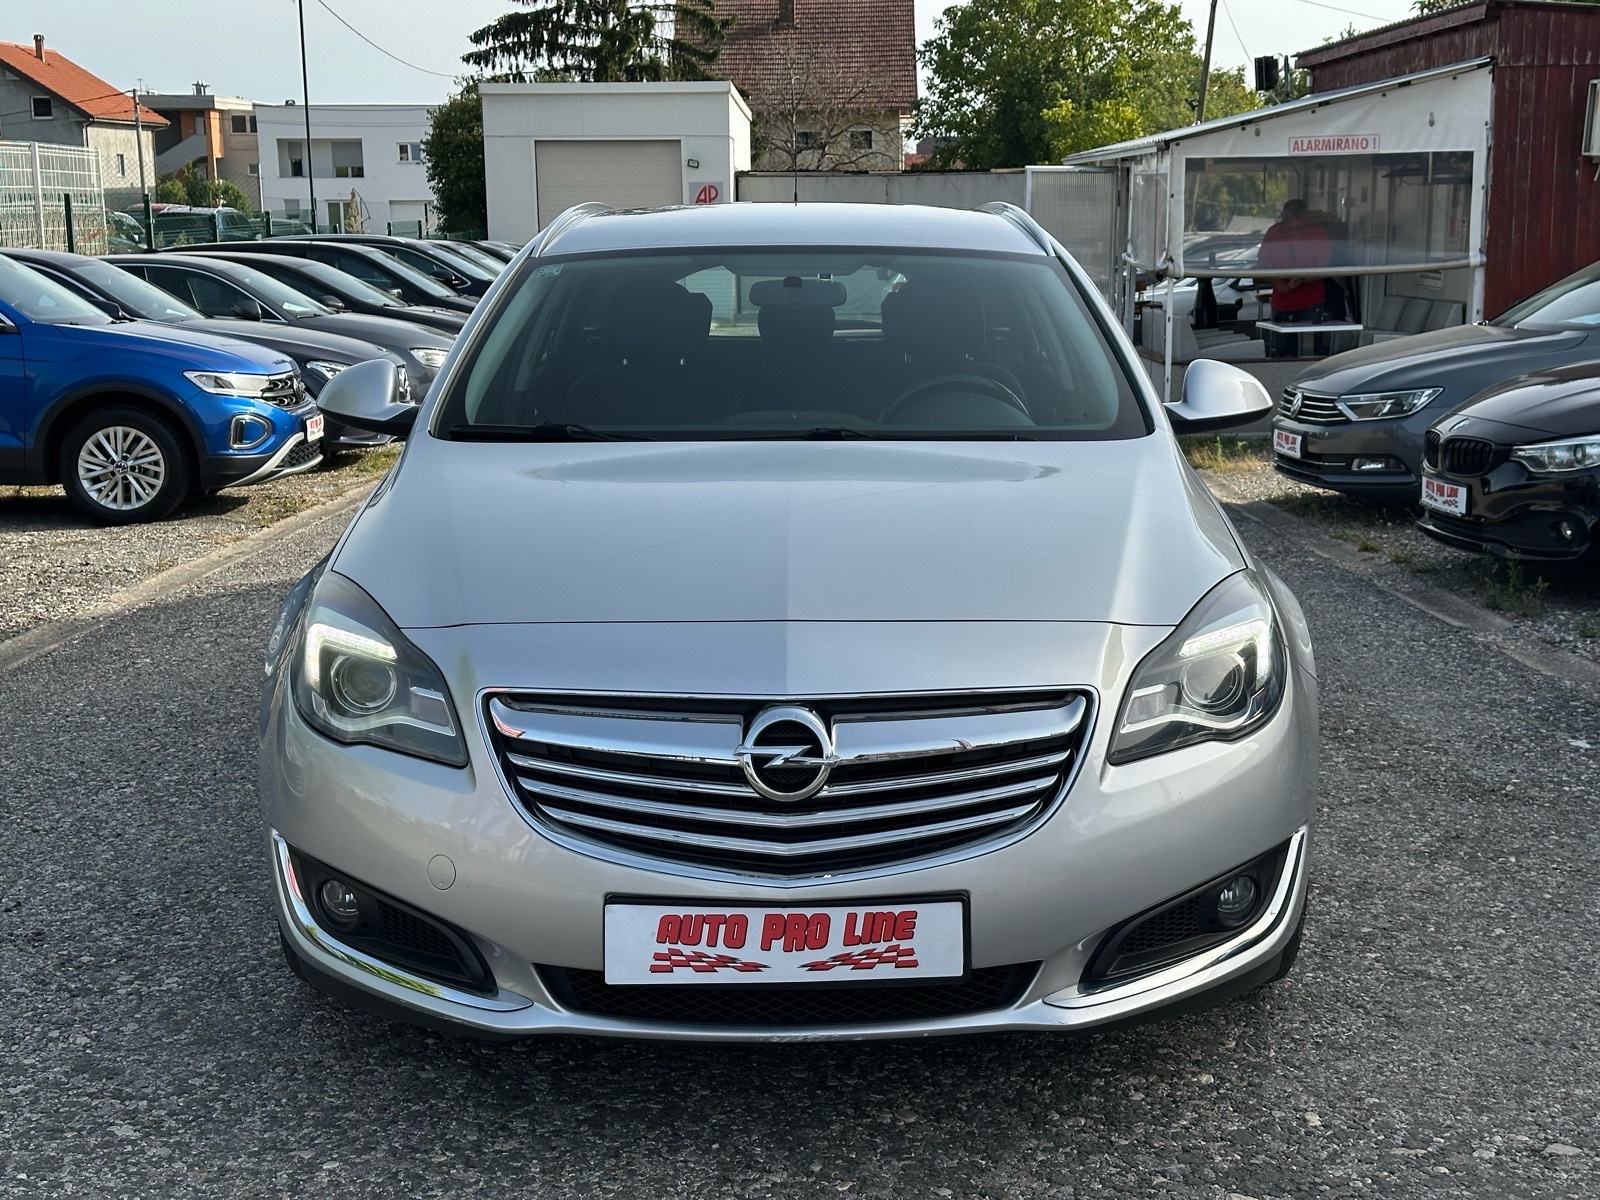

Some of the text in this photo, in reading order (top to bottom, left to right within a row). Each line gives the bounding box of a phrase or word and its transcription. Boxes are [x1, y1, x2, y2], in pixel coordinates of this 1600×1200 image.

[1292, 137, 1369, 152] ALARMIRANO
[656, 911, 918, 952] AUTO PRO LINE
